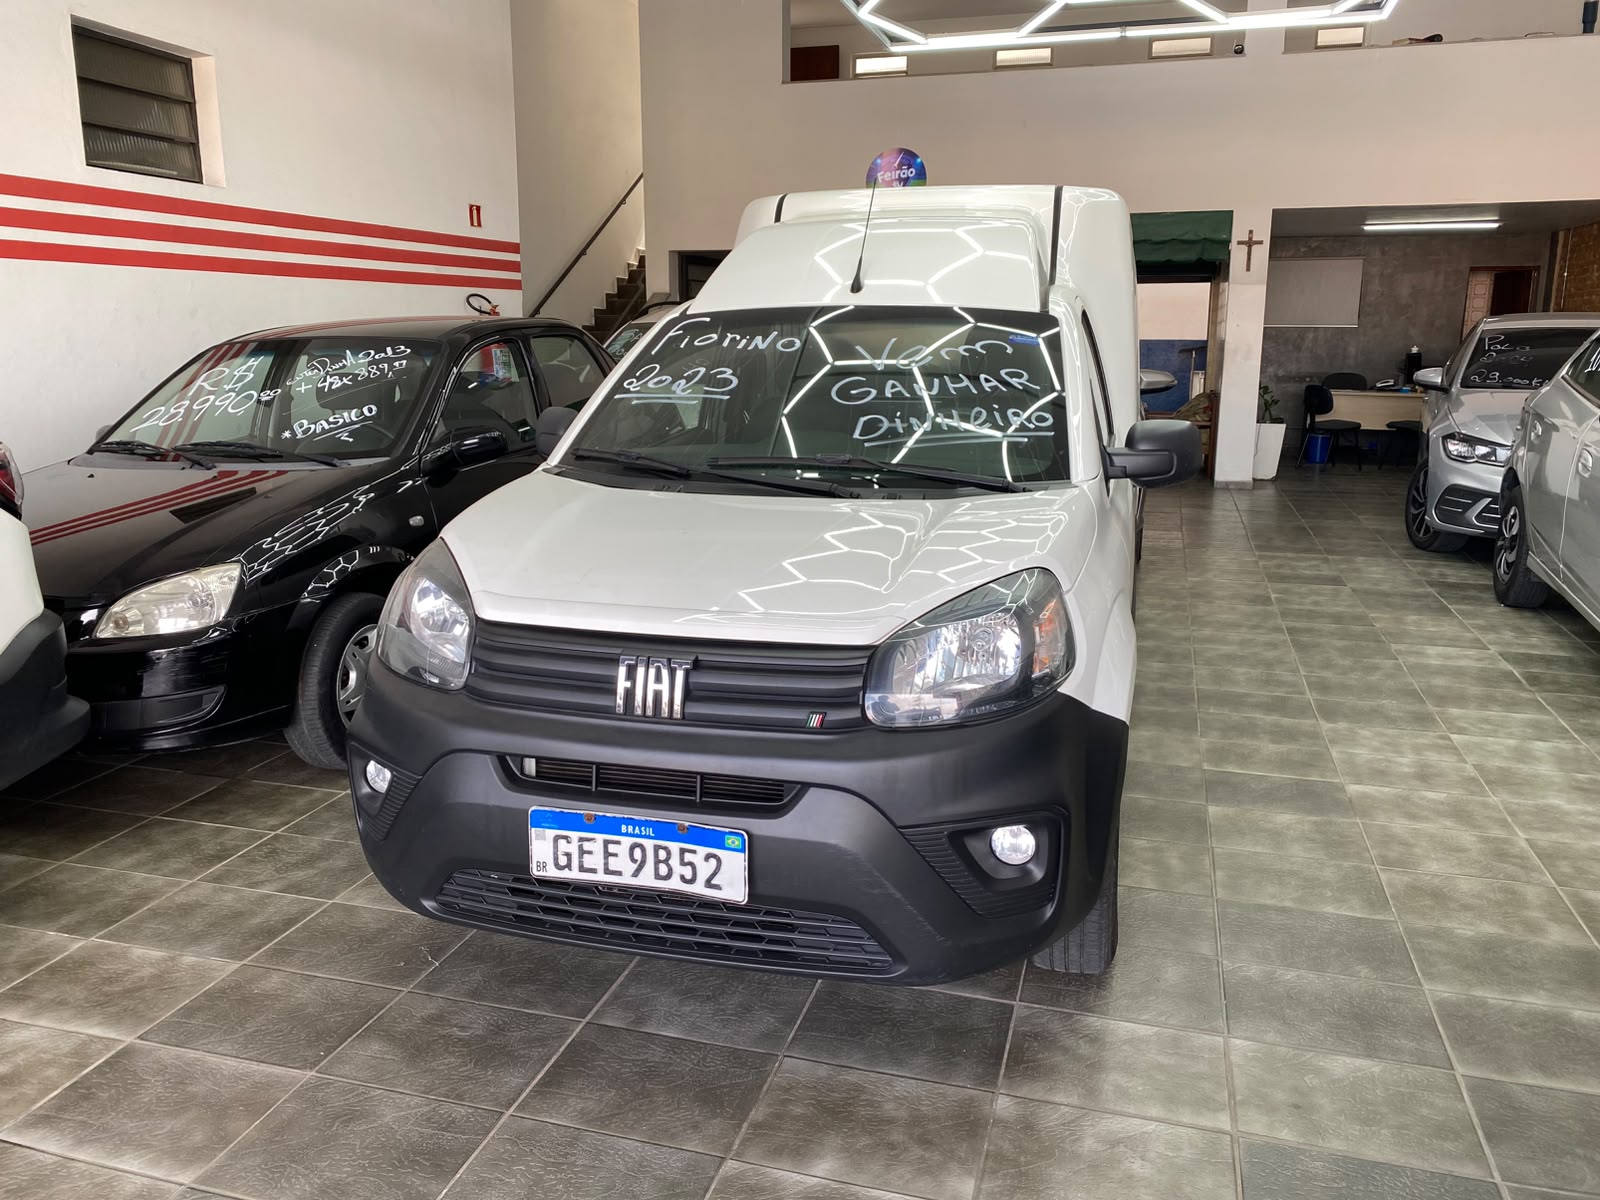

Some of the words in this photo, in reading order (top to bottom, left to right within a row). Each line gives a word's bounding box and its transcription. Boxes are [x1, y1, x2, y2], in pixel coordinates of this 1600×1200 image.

[877, 166, 916, 183] Feirão
[187, 356, 264, 396] R$
[623, 364, 738, 395] 2023
[831, 368, 1040, 405] GANHAR
[615, 655, 693, 720] FIAT
[621, 824, 655, 837] BRASIL
[536, 861, 548, 873] BR
[552, 834, 723, 891] GEE9B52
